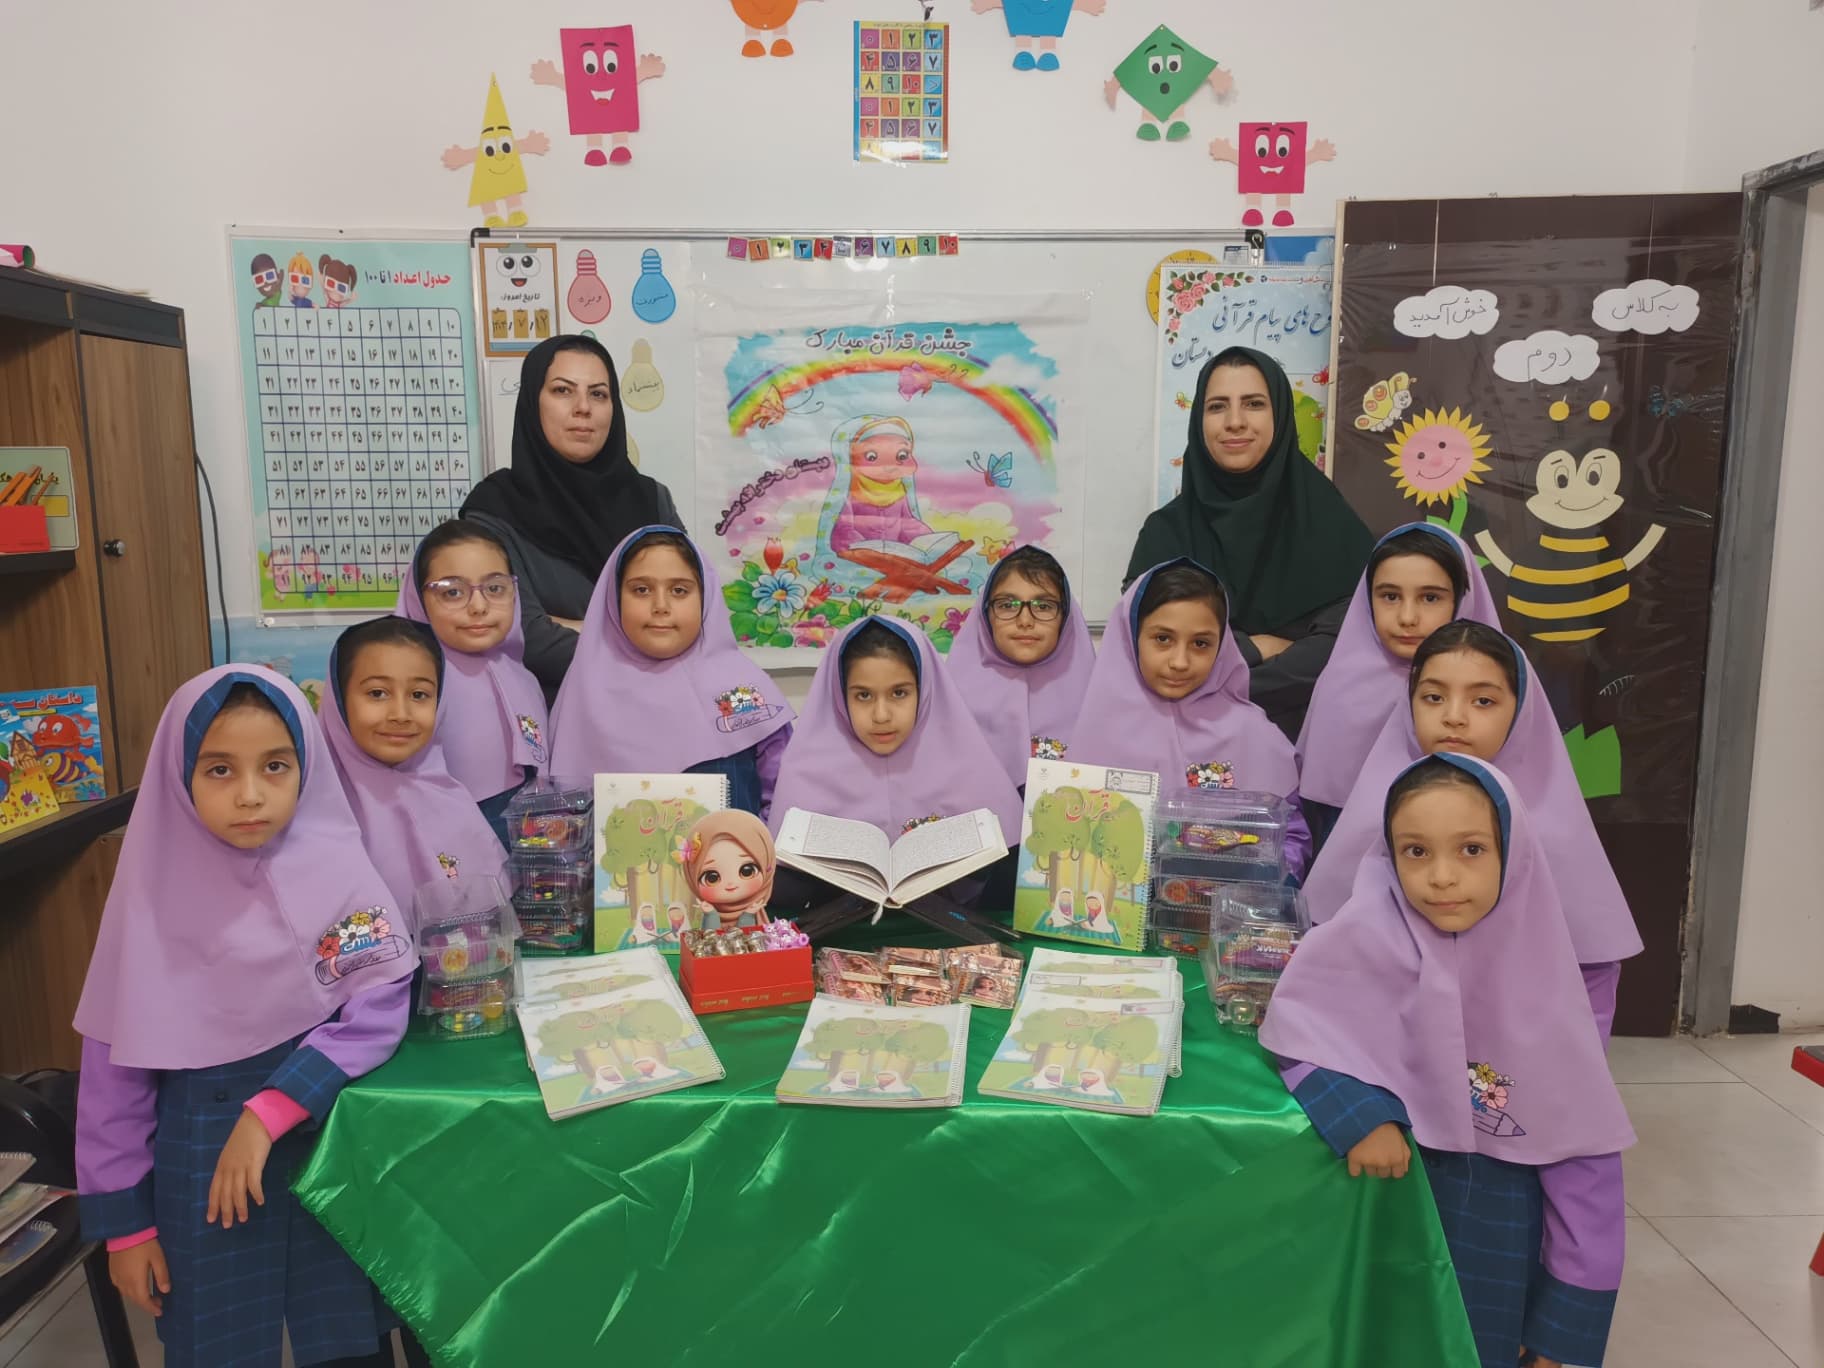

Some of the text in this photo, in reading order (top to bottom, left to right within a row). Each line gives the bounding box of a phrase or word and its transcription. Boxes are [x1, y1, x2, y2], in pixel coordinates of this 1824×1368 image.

[889, 32, 892, 46] ۱
[908, 33, 916, 47] ۲
[929, 33, 938, 46] ۳
[866, 52, 938, 68] ۴ ۵ ۶ ۷
[865, 77, 874, 90] ۸
[888, 77, 894, 90] ۹
[888, 101, 892, 112] ۱
[908, 101, 915, 113] ۲
[928, 101, 937, 113] ۳
[866, 121, 936, 135] ۴ ۵ ۶ ۷
[777, 241, 784, 253] ۲
[798, 244, 808, 256] ۳
[820, 242, 828, 254] ۴
[859, 240, 867, 253] ۶
[881, 241, 889, 253] ۷
[902, 242, 911, 253] ۸
[923, 239, 930, 253] ۹
[943, 238, 956, 249] ۱۰
[365, 272, 378, 283] ۱۰۰
[379, 271, 386, 284] تا
[393, 271, 421, 283] اعداد
[423, 273, 451, 288] جدول
[1611, 289, 1679, 320] به کلاس
[1212, 295, 1257, 333] قرآنی
[1409, 296, 1487, 328] خوش آمدید
[447, 320, 454, 331] ۱۰
[1253, 307, 1281, 345] پیام
[805, 328, 972, 358] جشن قرآن مبارک
[263, 348, 458, 361] ۱۱ ۱۲ ۱۳ ۱۴ ۱۵ ۱۶ ۱۷ ۱۸ ۱۹ ۲۰
[1527, 347, 1572, 381] دوم
[266, 377, 459, 390] ۲۱ ۲۲ ۲۳ ۲۴ ۲۵ ۲۶ ۲۷ ۲۸ ۲۹ ۳۰
[268, 406, 462, 418] ۳۱ ۳۲ ۳۳ ۳۴ ۳۵ ۳۶ ۳۷ ۳۸ ۳۹ ۴۰
[270, 430, 462, 443] ۴۱ ۴۲ ۴۳ ۴۴ ۴۵ ۴۶ ۴۷ ۴۸ ۴۹ ۵۰
[272, 459, 464, 472] ۵۱ ۵۲ ۵۳ ۵۴ ۵۵ ۵۶ ۵۷ ۵۸ ۵۹ ۶۰
[275, 488, 284, 500] ۶۱
[295, 488, 305, 499] ۶۲
[314, 488, 326, 499] ۶۳
[335, 488, 346, 499] ۶۴
[356, 488, 366, 500] ۶۵
[377, 488, 389, 499] ۶۶
[396, 488, 406, 499] ۶۷
[417, 488, 427, 499] ۶۸
[436, 488, 446, 499] ۶۹
[276, 516, 287, 527] ۷۱
[297, 516, 308, 526] ۷۲
[316, 516, 328, 526] ۷۳
[337, 516, 349, 526] ۷۴
[358, 516, 369, 527] ۷۵
[379, 516, 390, 526] ۷۶
[398, 516, 409, 526] ۷۷
[419, 516, 430, 526] ۷۸
[279, 544, 410, 555] ۸۱ ۸۲ ۸۳ ۸۴ ۸۵ ۸۶ ۸۷
